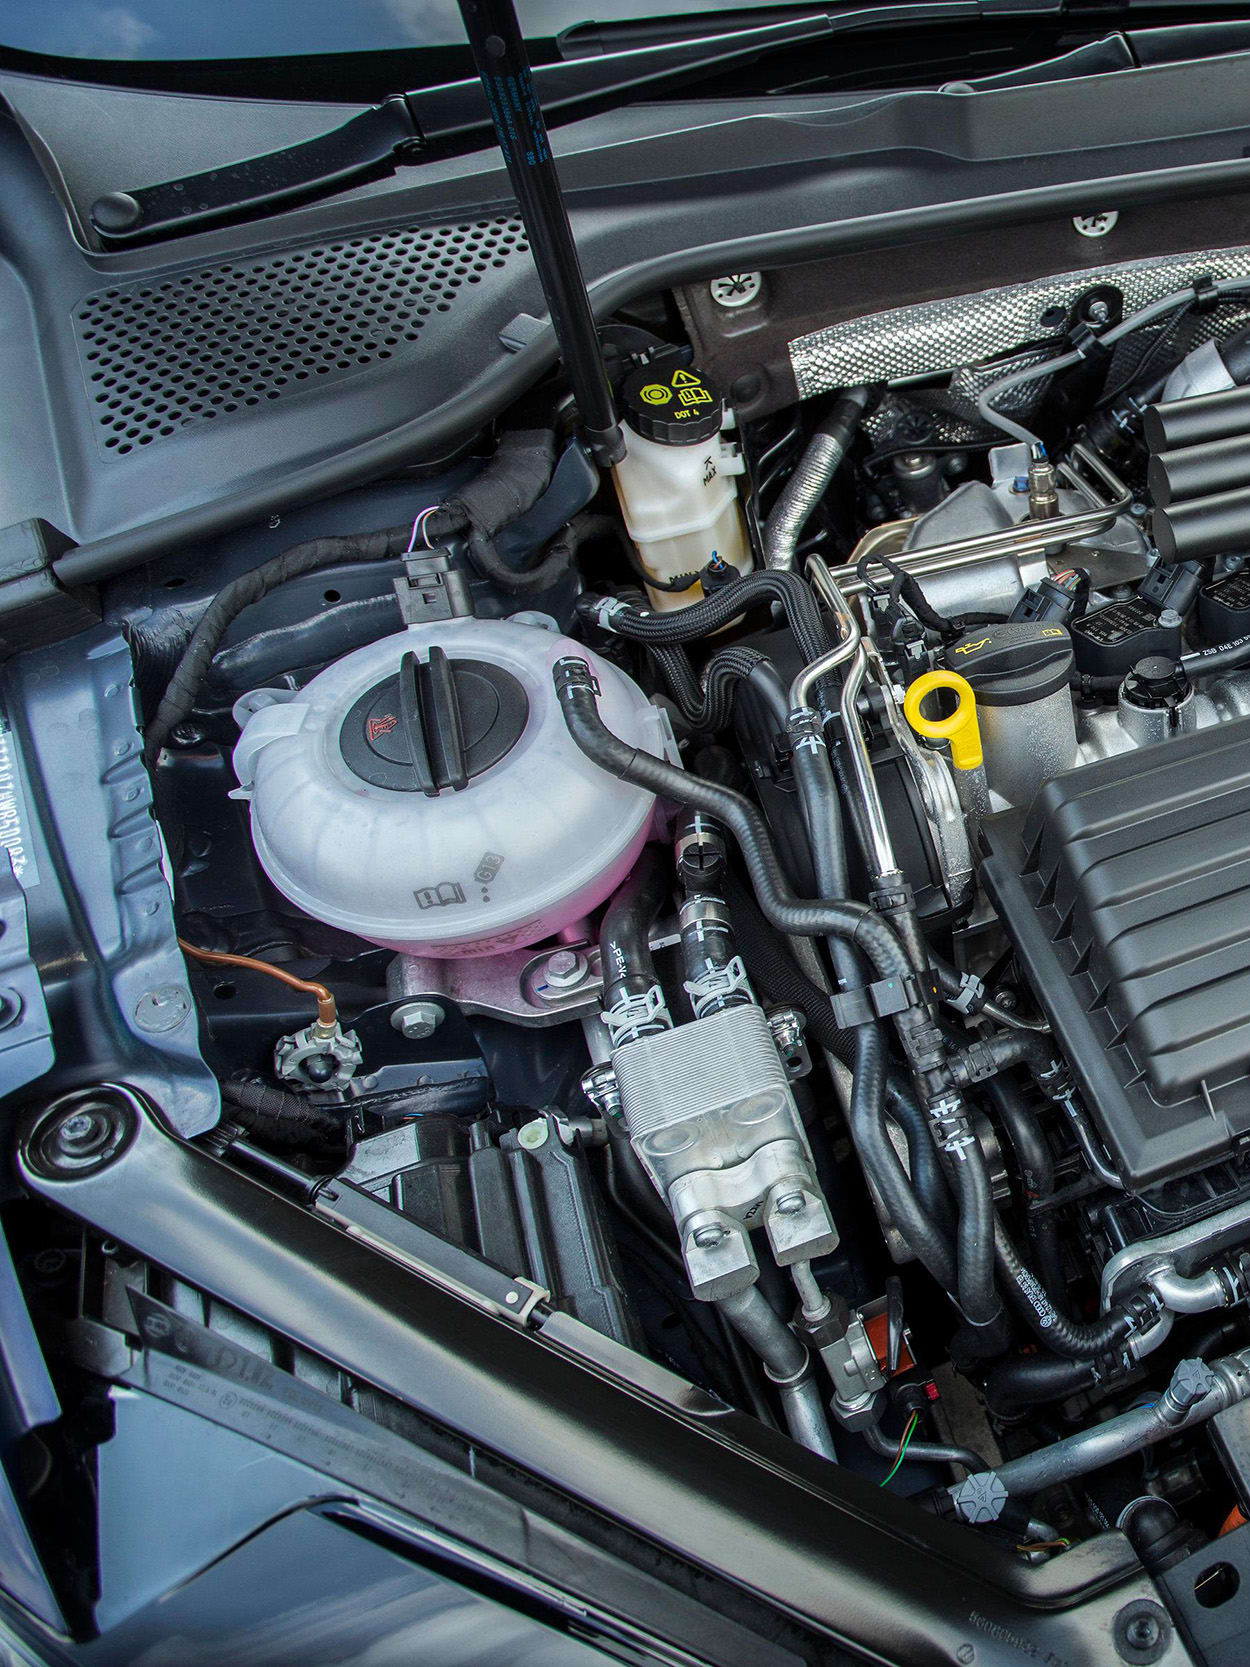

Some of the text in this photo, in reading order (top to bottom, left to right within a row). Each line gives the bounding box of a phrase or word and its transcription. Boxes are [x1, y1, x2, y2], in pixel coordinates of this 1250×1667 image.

[674, 408, 700, 420] DOT 4
[476, 855, 501, 881] G13
